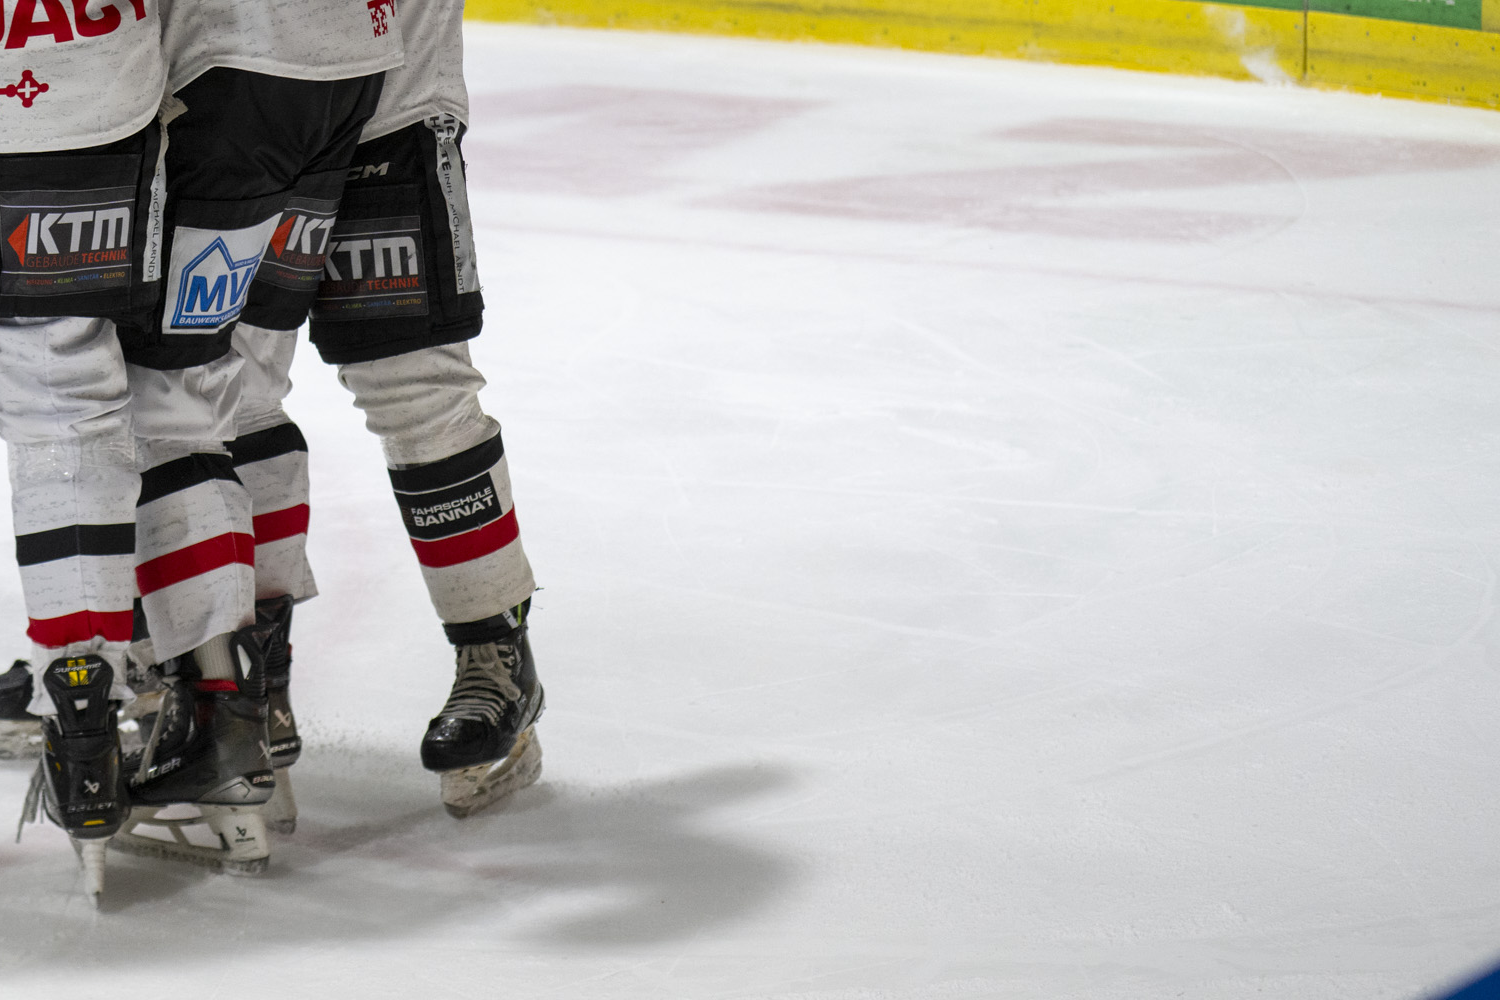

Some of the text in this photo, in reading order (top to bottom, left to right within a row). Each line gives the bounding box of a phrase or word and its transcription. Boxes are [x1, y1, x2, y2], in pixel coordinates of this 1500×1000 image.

[27, 207, 131, 254] KTM
[184, 265, 254, 314] MV
[411, 486, 493, 517] FAHRSCHULE
[414, 494, 494, 528] BANNAT
